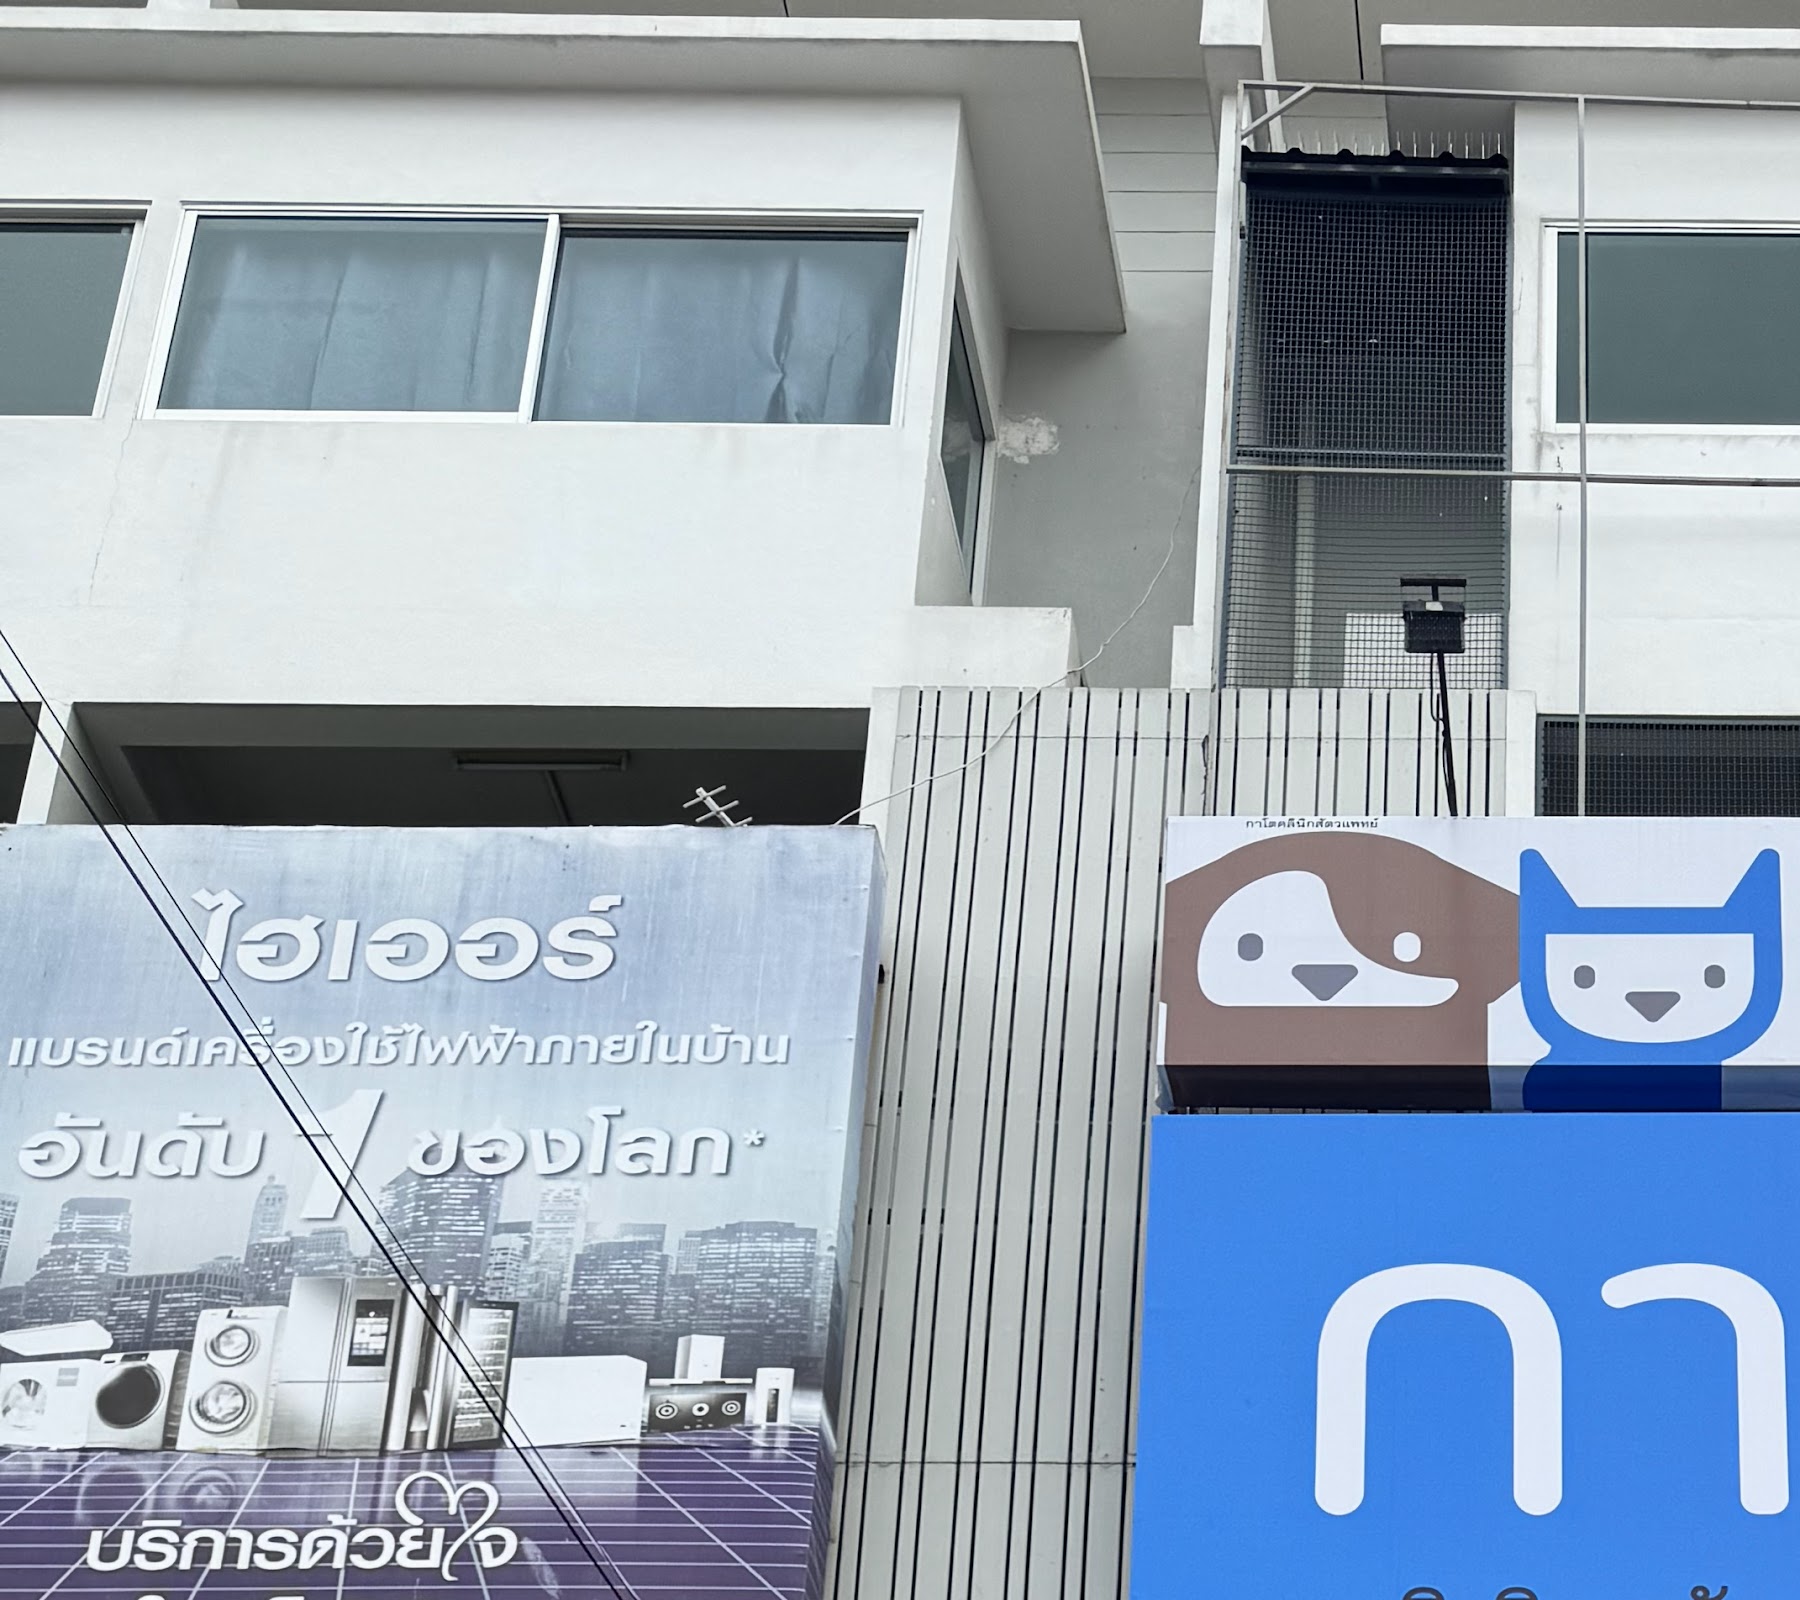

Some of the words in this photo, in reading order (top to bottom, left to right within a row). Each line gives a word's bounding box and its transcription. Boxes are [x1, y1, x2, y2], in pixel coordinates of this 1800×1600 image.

[191, 888, 624, 983] ไฮเออร์
[8, 1016, 790, 1068] แบรนด์เครื่องใช้ไฟฟ้าภายในบ้าน
[18, 1112, 267, 1180] อันดับ
[294, 1089, 385, 1219] 1
